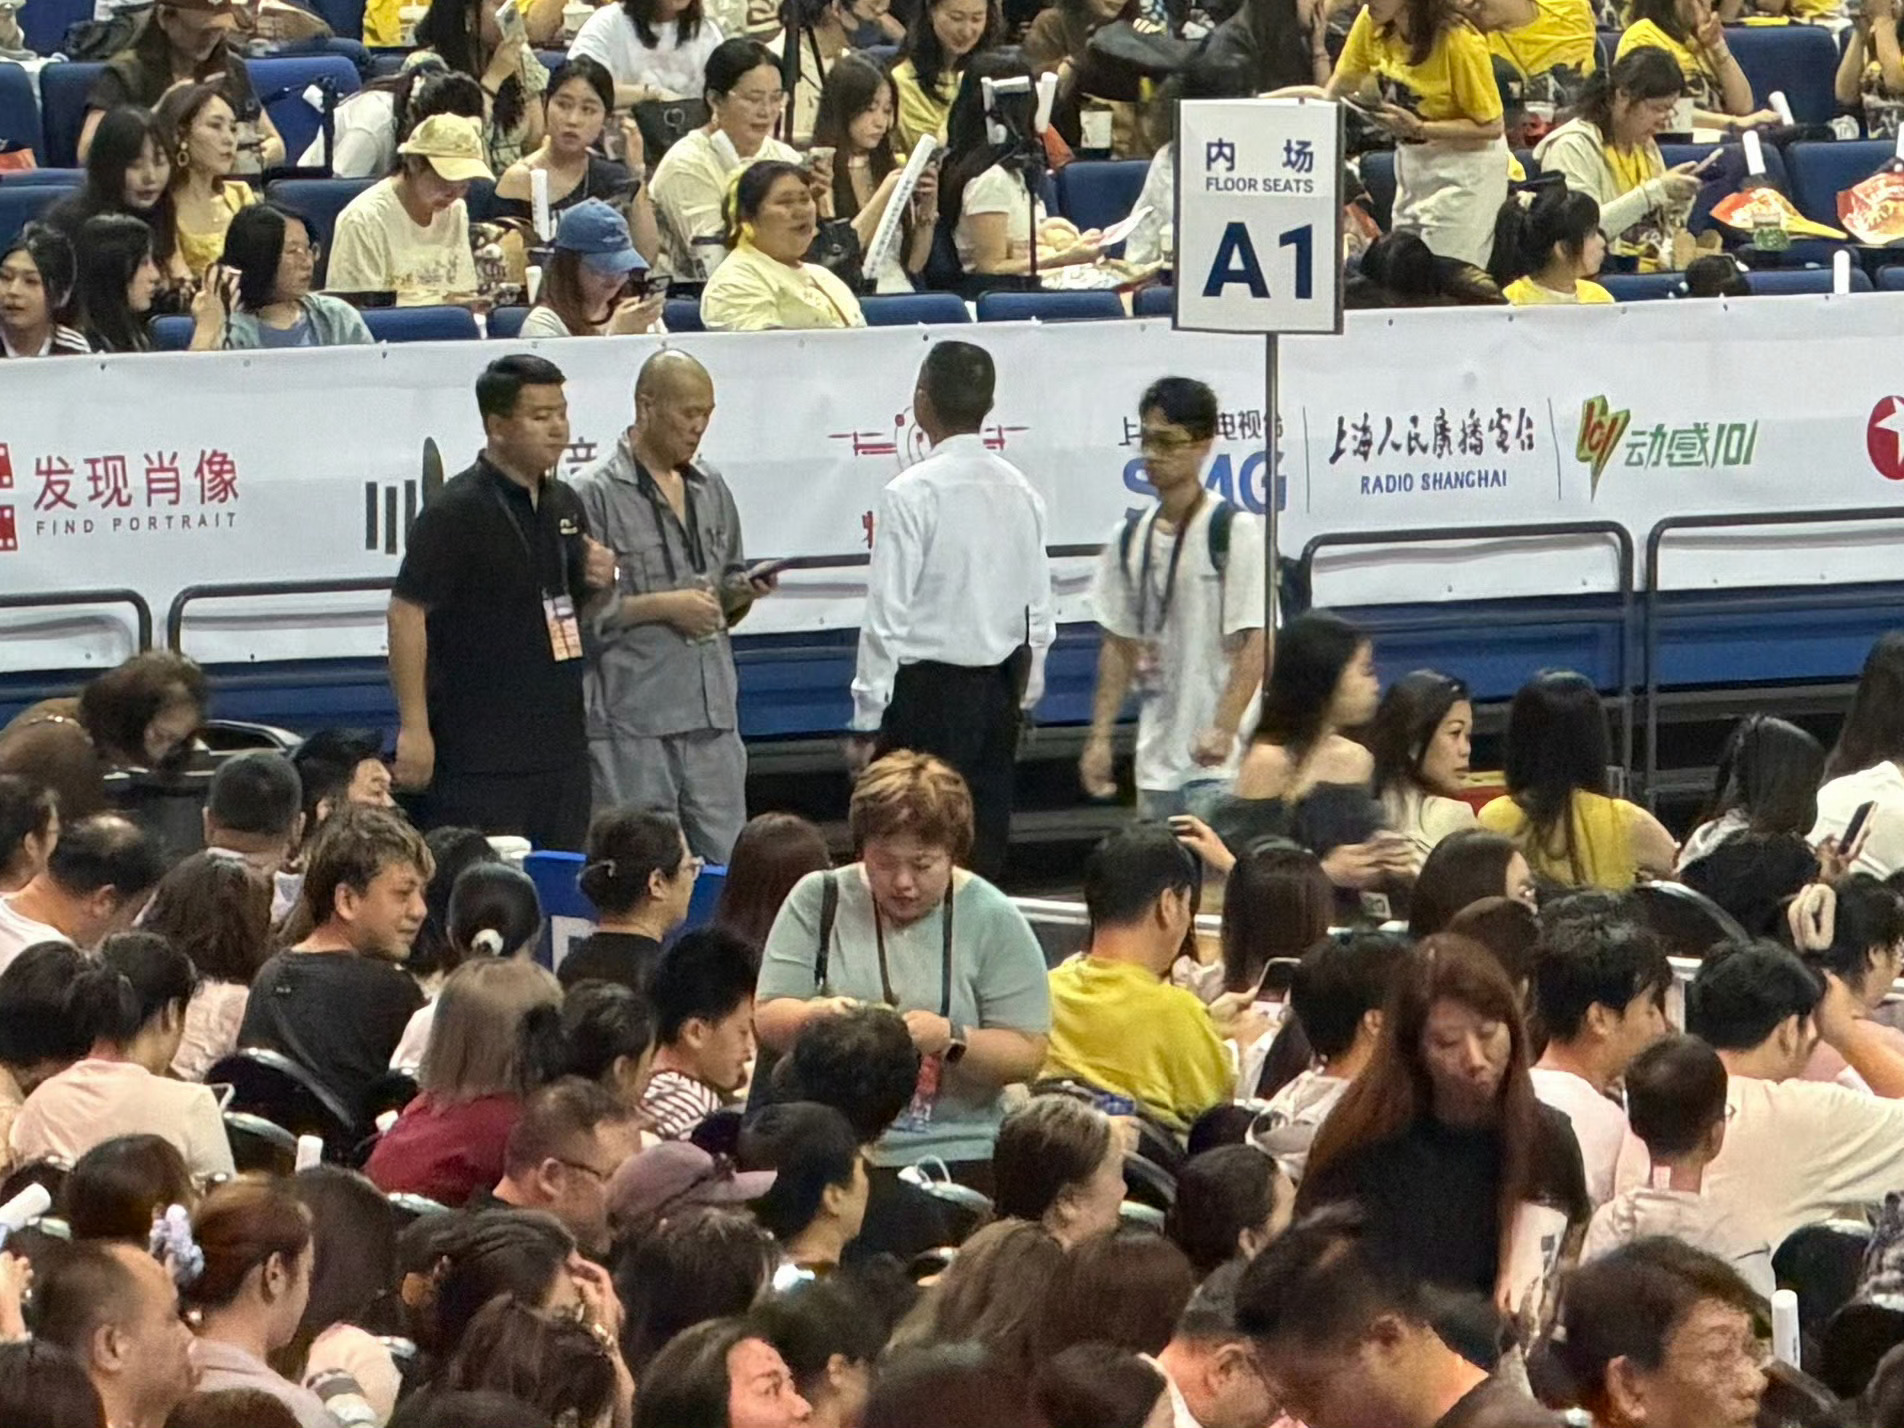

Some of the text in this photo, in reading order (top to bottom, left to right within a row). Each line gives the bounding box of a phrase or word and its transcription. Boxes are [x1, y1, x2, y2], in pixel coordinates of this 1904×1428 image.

[1206, 177, 1314, 193] FLOOR SEATS
[1202, 221, 1312, 299] A1
[33, 449, 239, 511] 发现肖像
[1360, 469, 1507, 494] RADIO SHANGHAI
[36, 513, 236, 536] FIND PORTRAIT
